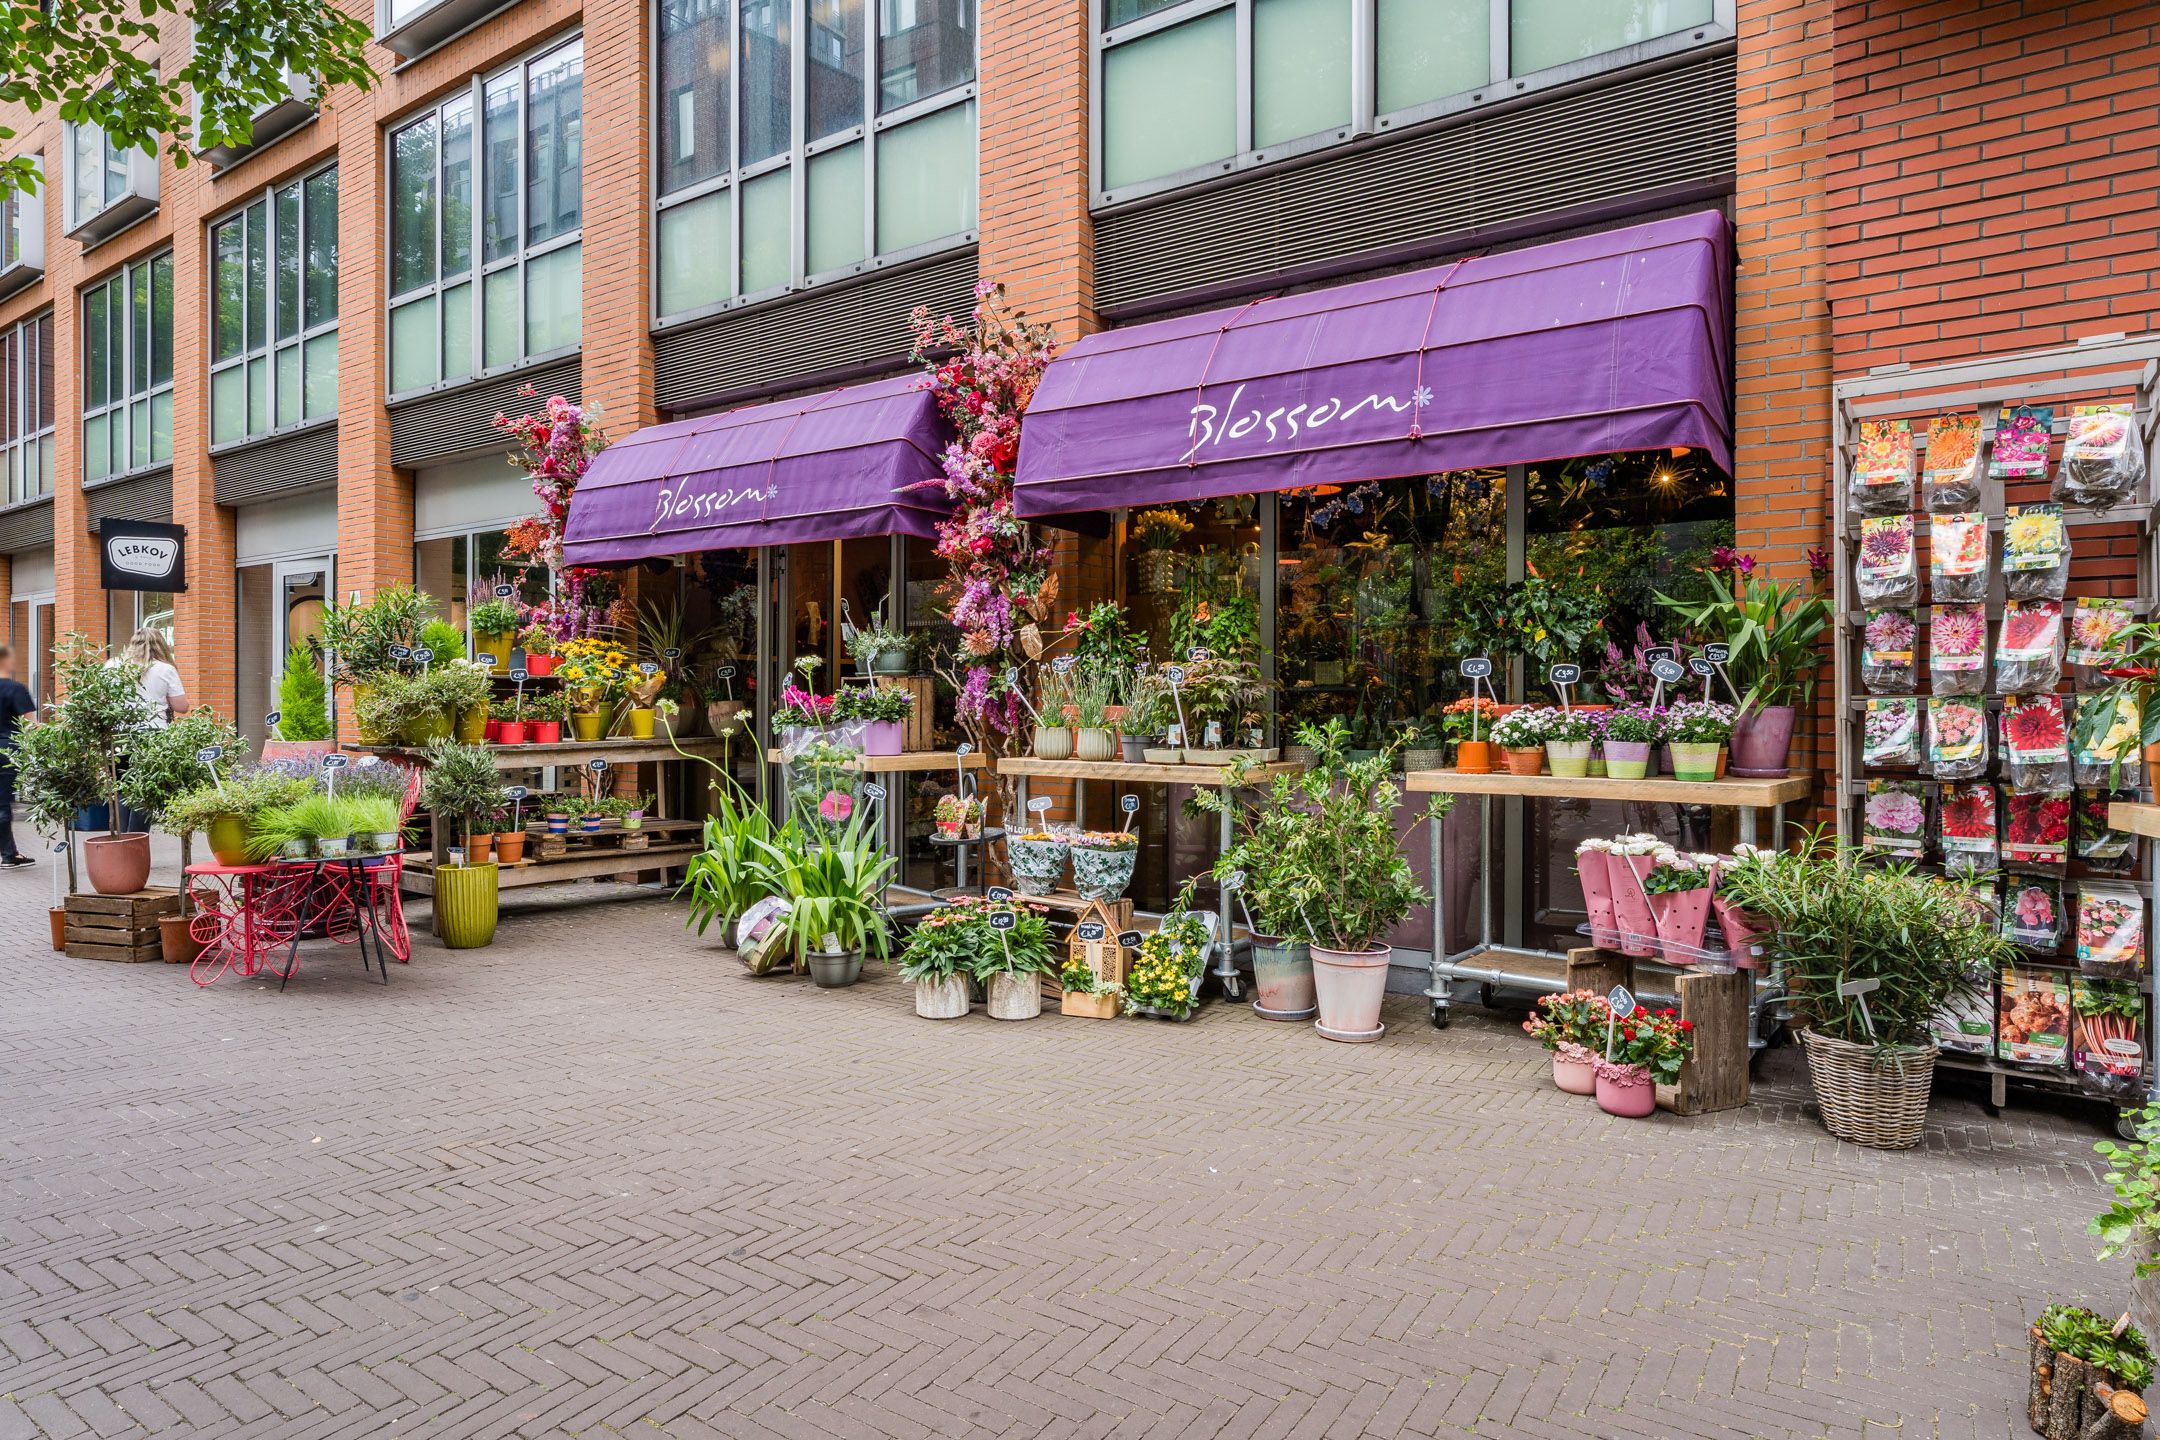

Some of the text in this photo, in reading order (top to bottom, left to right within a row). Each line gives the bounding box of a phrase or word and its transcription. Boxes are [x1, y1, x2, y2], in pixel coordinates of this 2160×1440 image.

[1179, 384, 1411, 462] Blossom
[649, 476, 767, 531] Blossom
[118, 545, 168, 559] LEBKOV
[1014, 825, 1034, 834] LOVE
